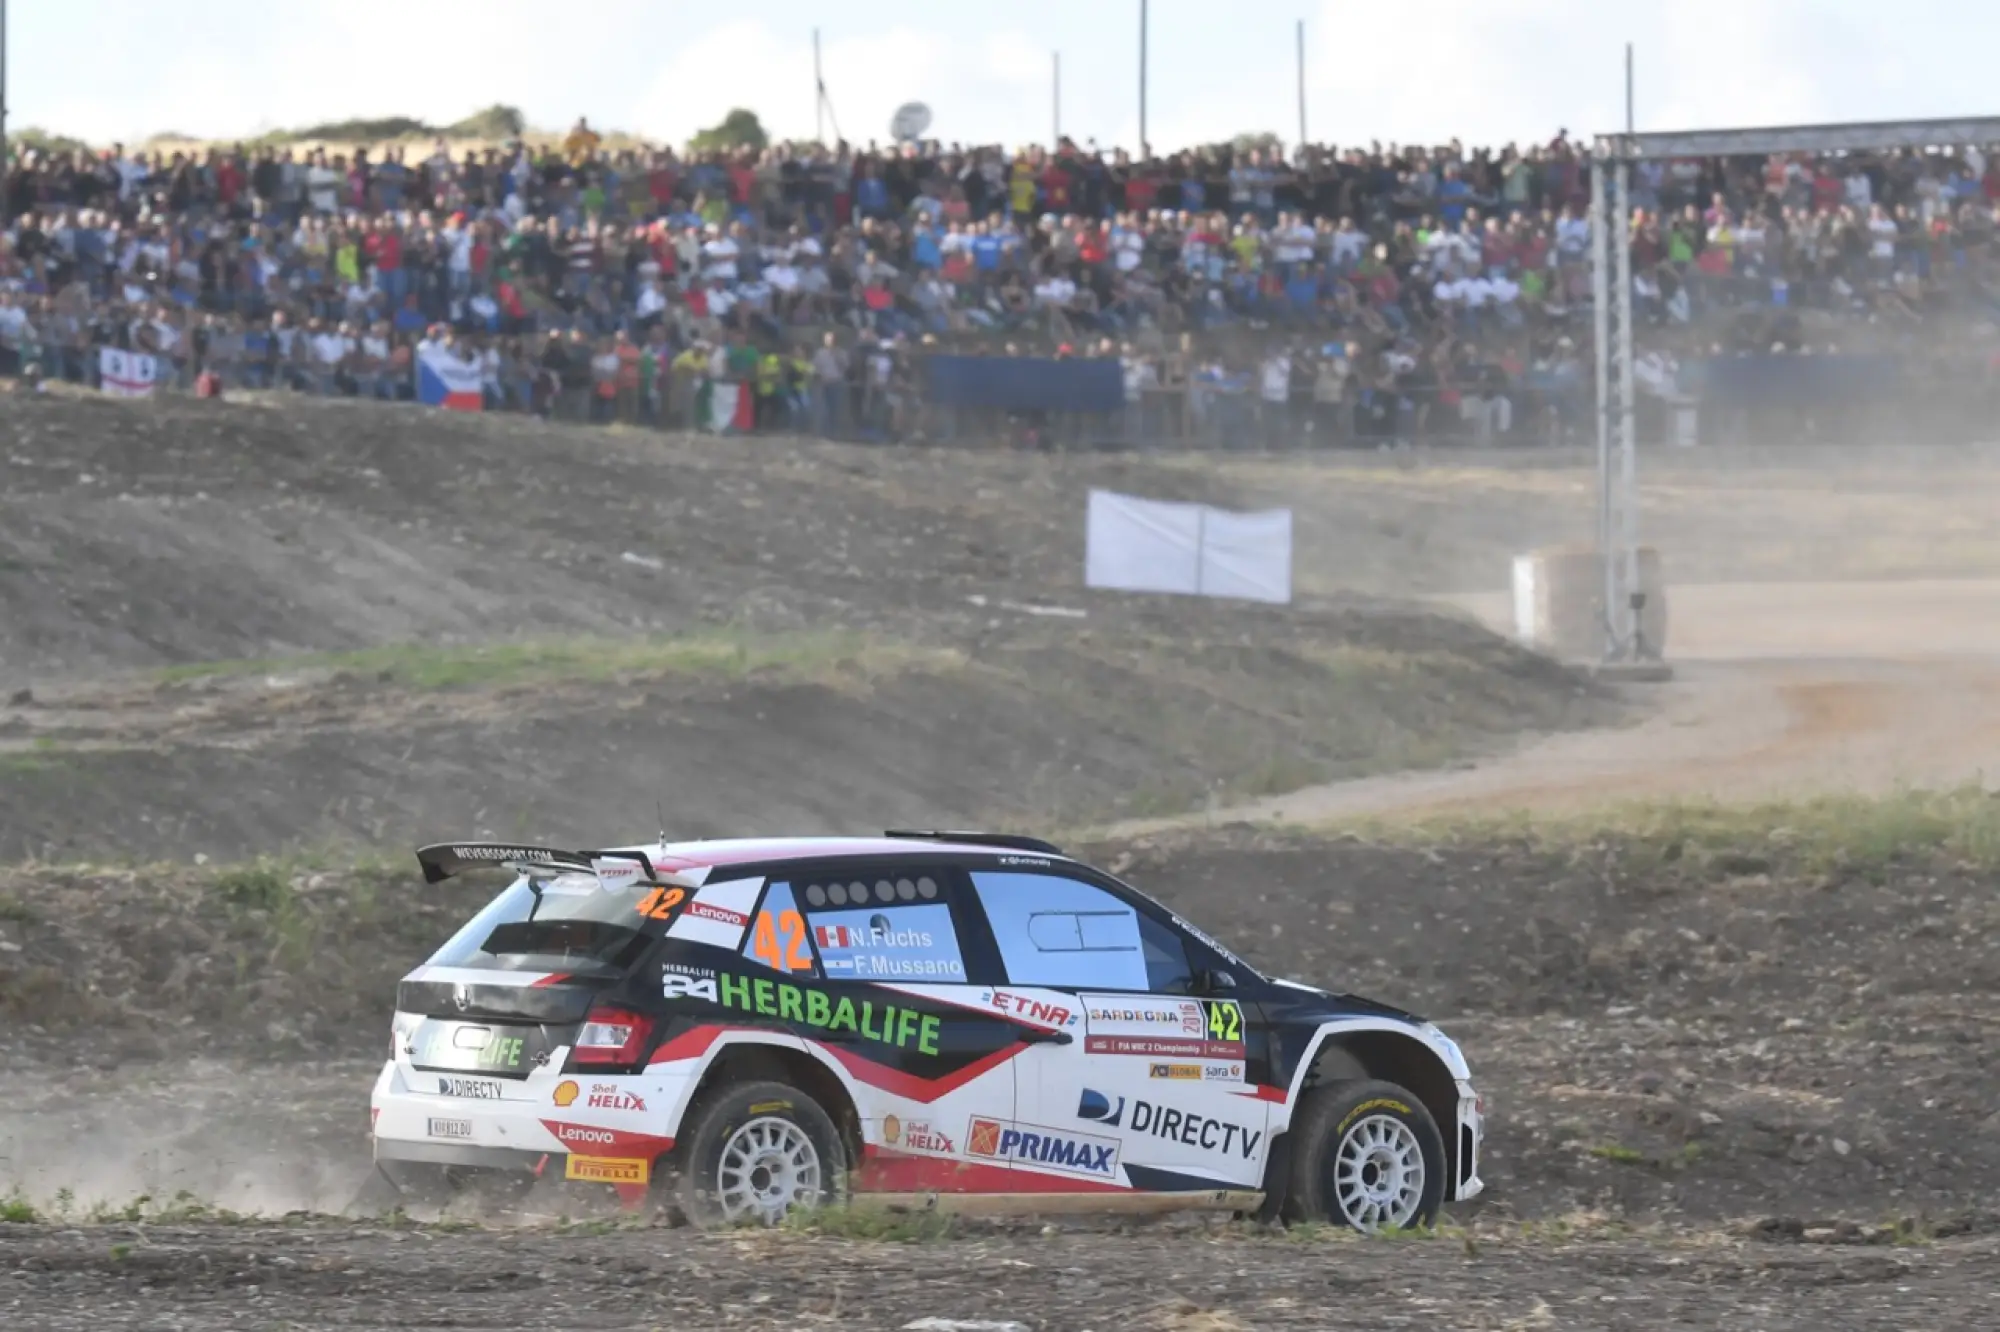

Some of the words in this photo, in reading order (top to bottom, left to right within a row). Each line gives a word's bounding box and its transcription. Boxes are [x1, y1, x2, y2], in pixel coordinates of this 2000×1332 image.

[635, 886, 685, 919] 42
[691, 903, 742, 925] Lenovo
[754, 909, 813, 970] 42
[662, 963, 716, 978] HERBALIFE
[662, 973, 718, 1003] 24
[721, 972, 941, 1057] HERBALIFE
[1090, 1008, 1179, 1023] SARDEGNA
[1208, 1001, 1240, 1041] 42
[1154, 1042, 1200, 1055] Championship
[1205, 1065, 1229, 1078] sara
[455, 1080, 502, 1098] DIRECTV
[592, 1084, 617, 1095] Shell
[587, 1091, 647, 1112] HELIX
[559, 1123, 614, 1144] Lenovo
[1131, 1100, 1261, 1160] DIRECTV
[906, 1133, 955, 1153] HELIX
[1000, 1129, 1115, 1172] PRIMAX
[574, 1159, 639, 1179] PIRELLI
